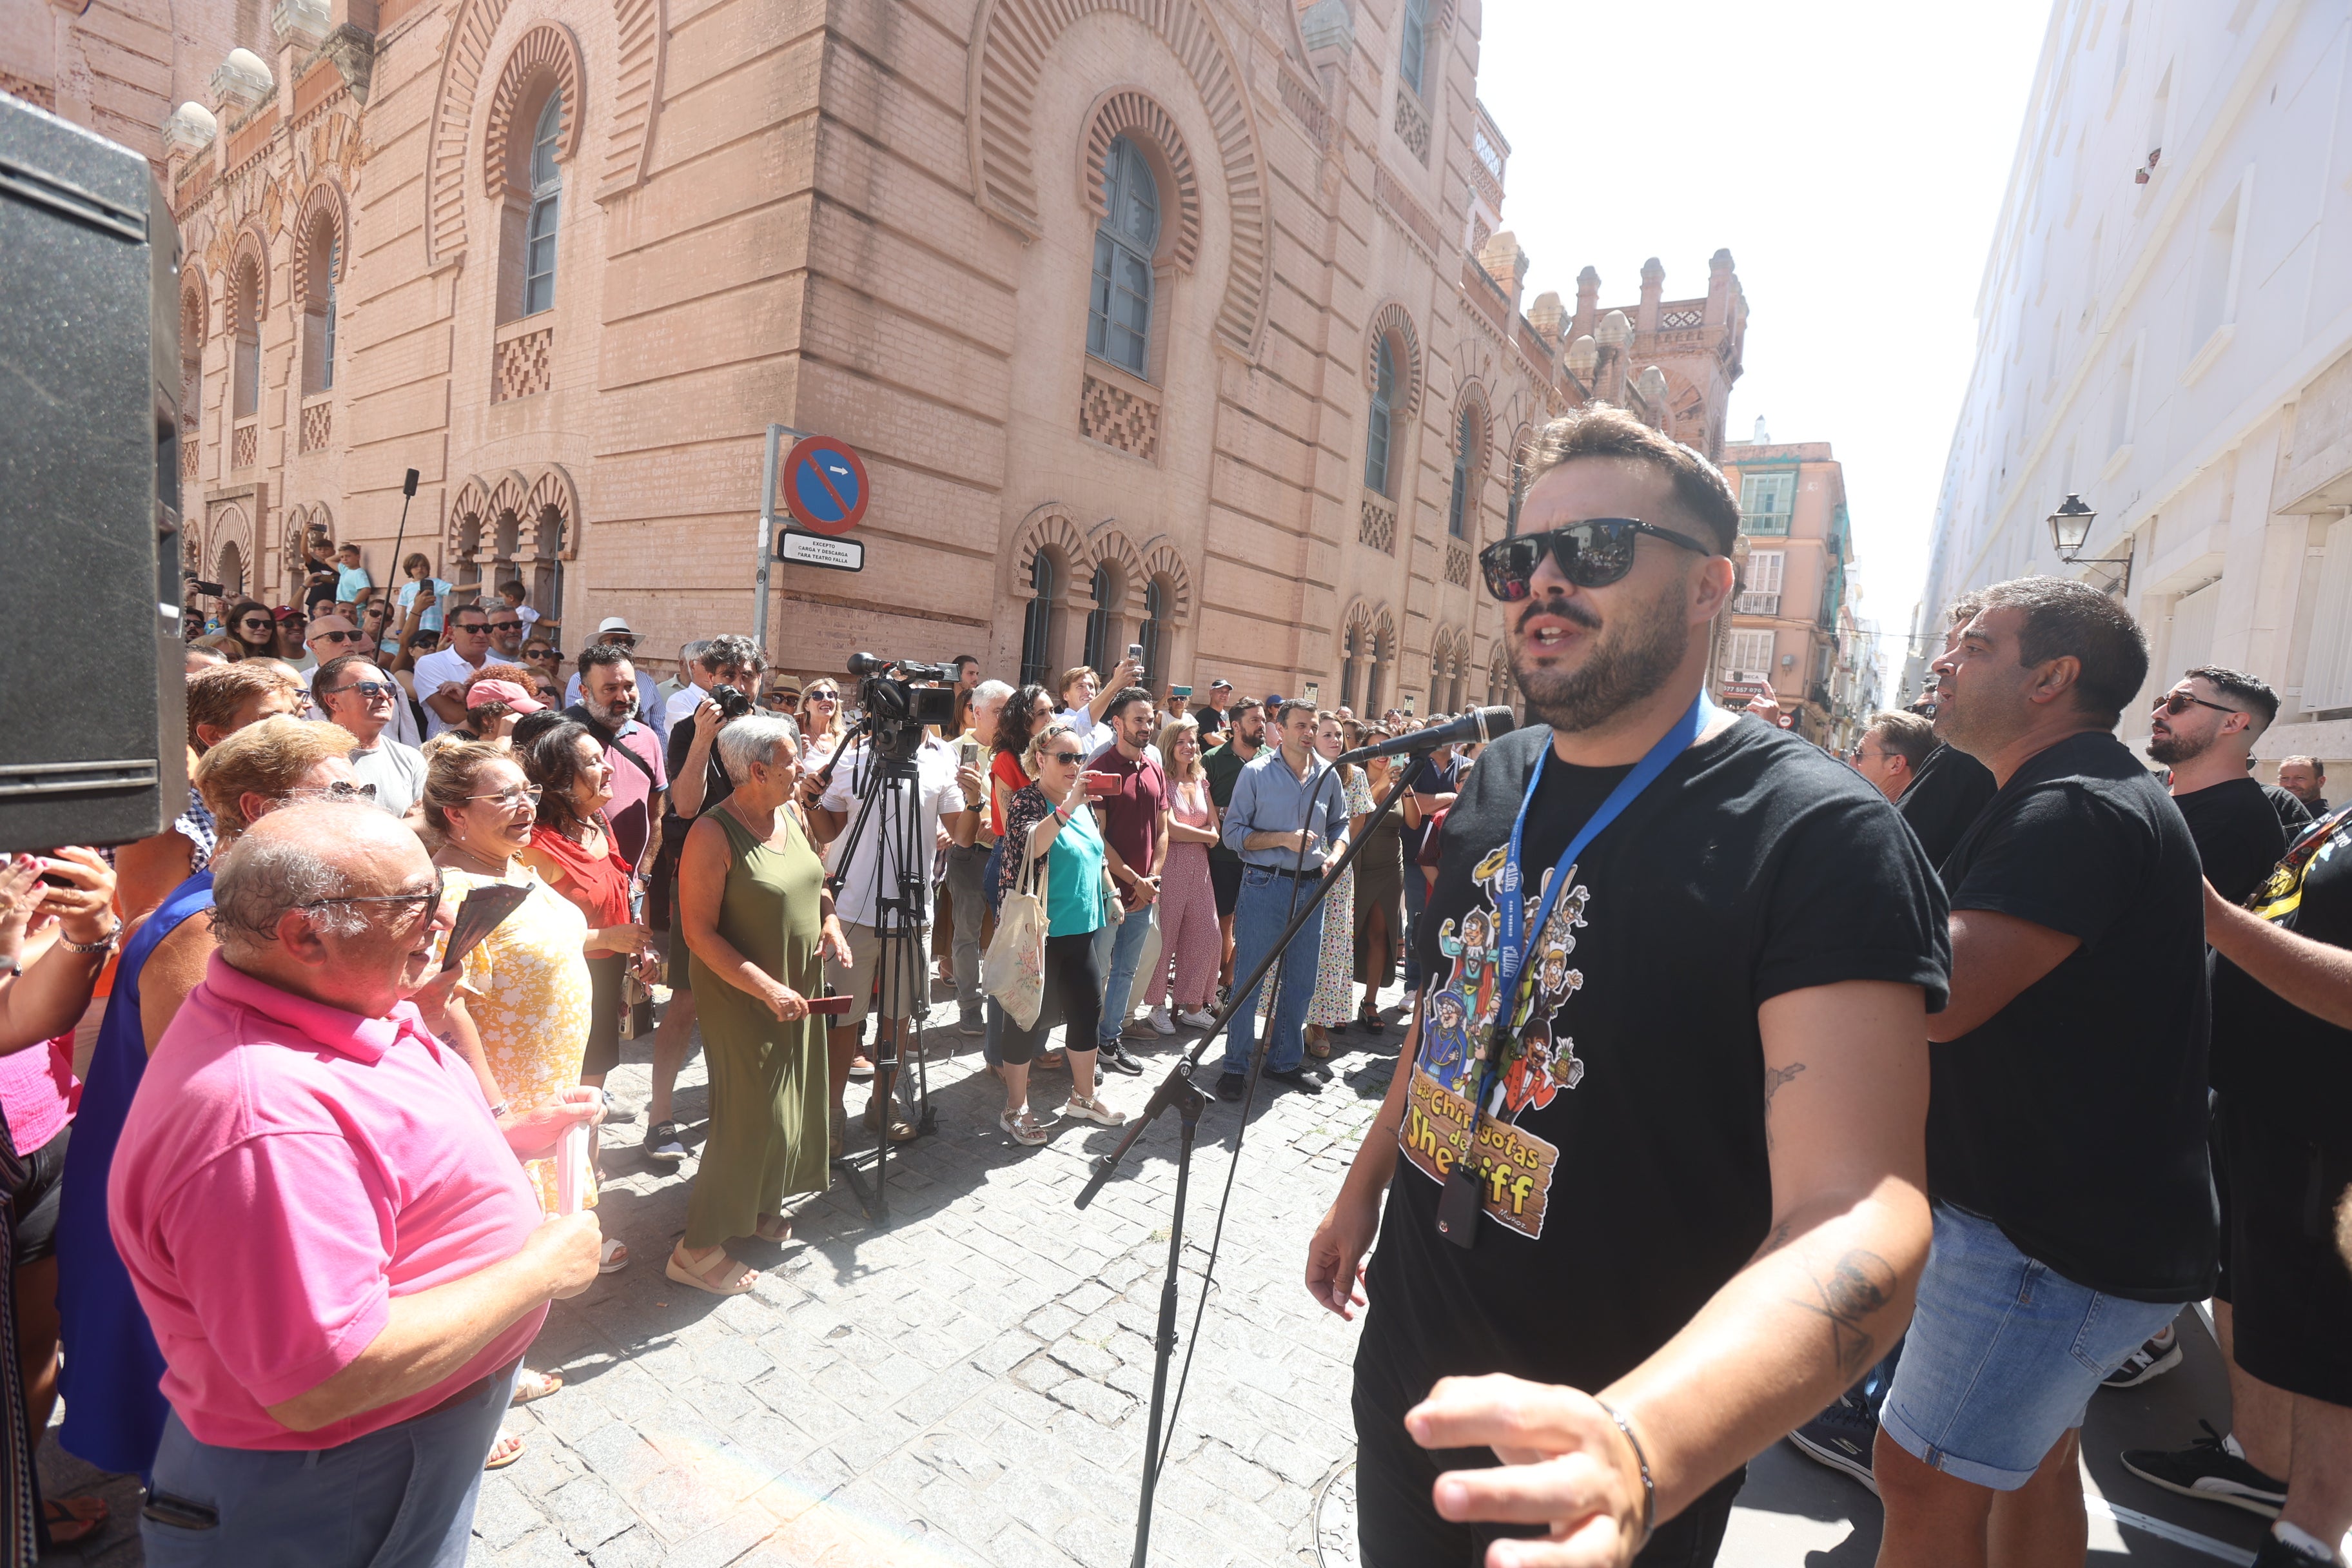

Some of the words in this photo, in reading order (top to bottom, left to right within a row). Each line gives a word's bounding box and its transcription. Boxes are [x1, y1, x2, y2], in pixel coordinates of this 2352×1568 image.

[822, 549, 848, 557] DESCARGA
[1504, 861, 1519, 892] EXÓTICA
[1502, 945, 1519, 978] EXÓTICA
[1416, 1075, 1431, 1099] Las
[1430, 1089, 1540, 1170] Chirigotas
